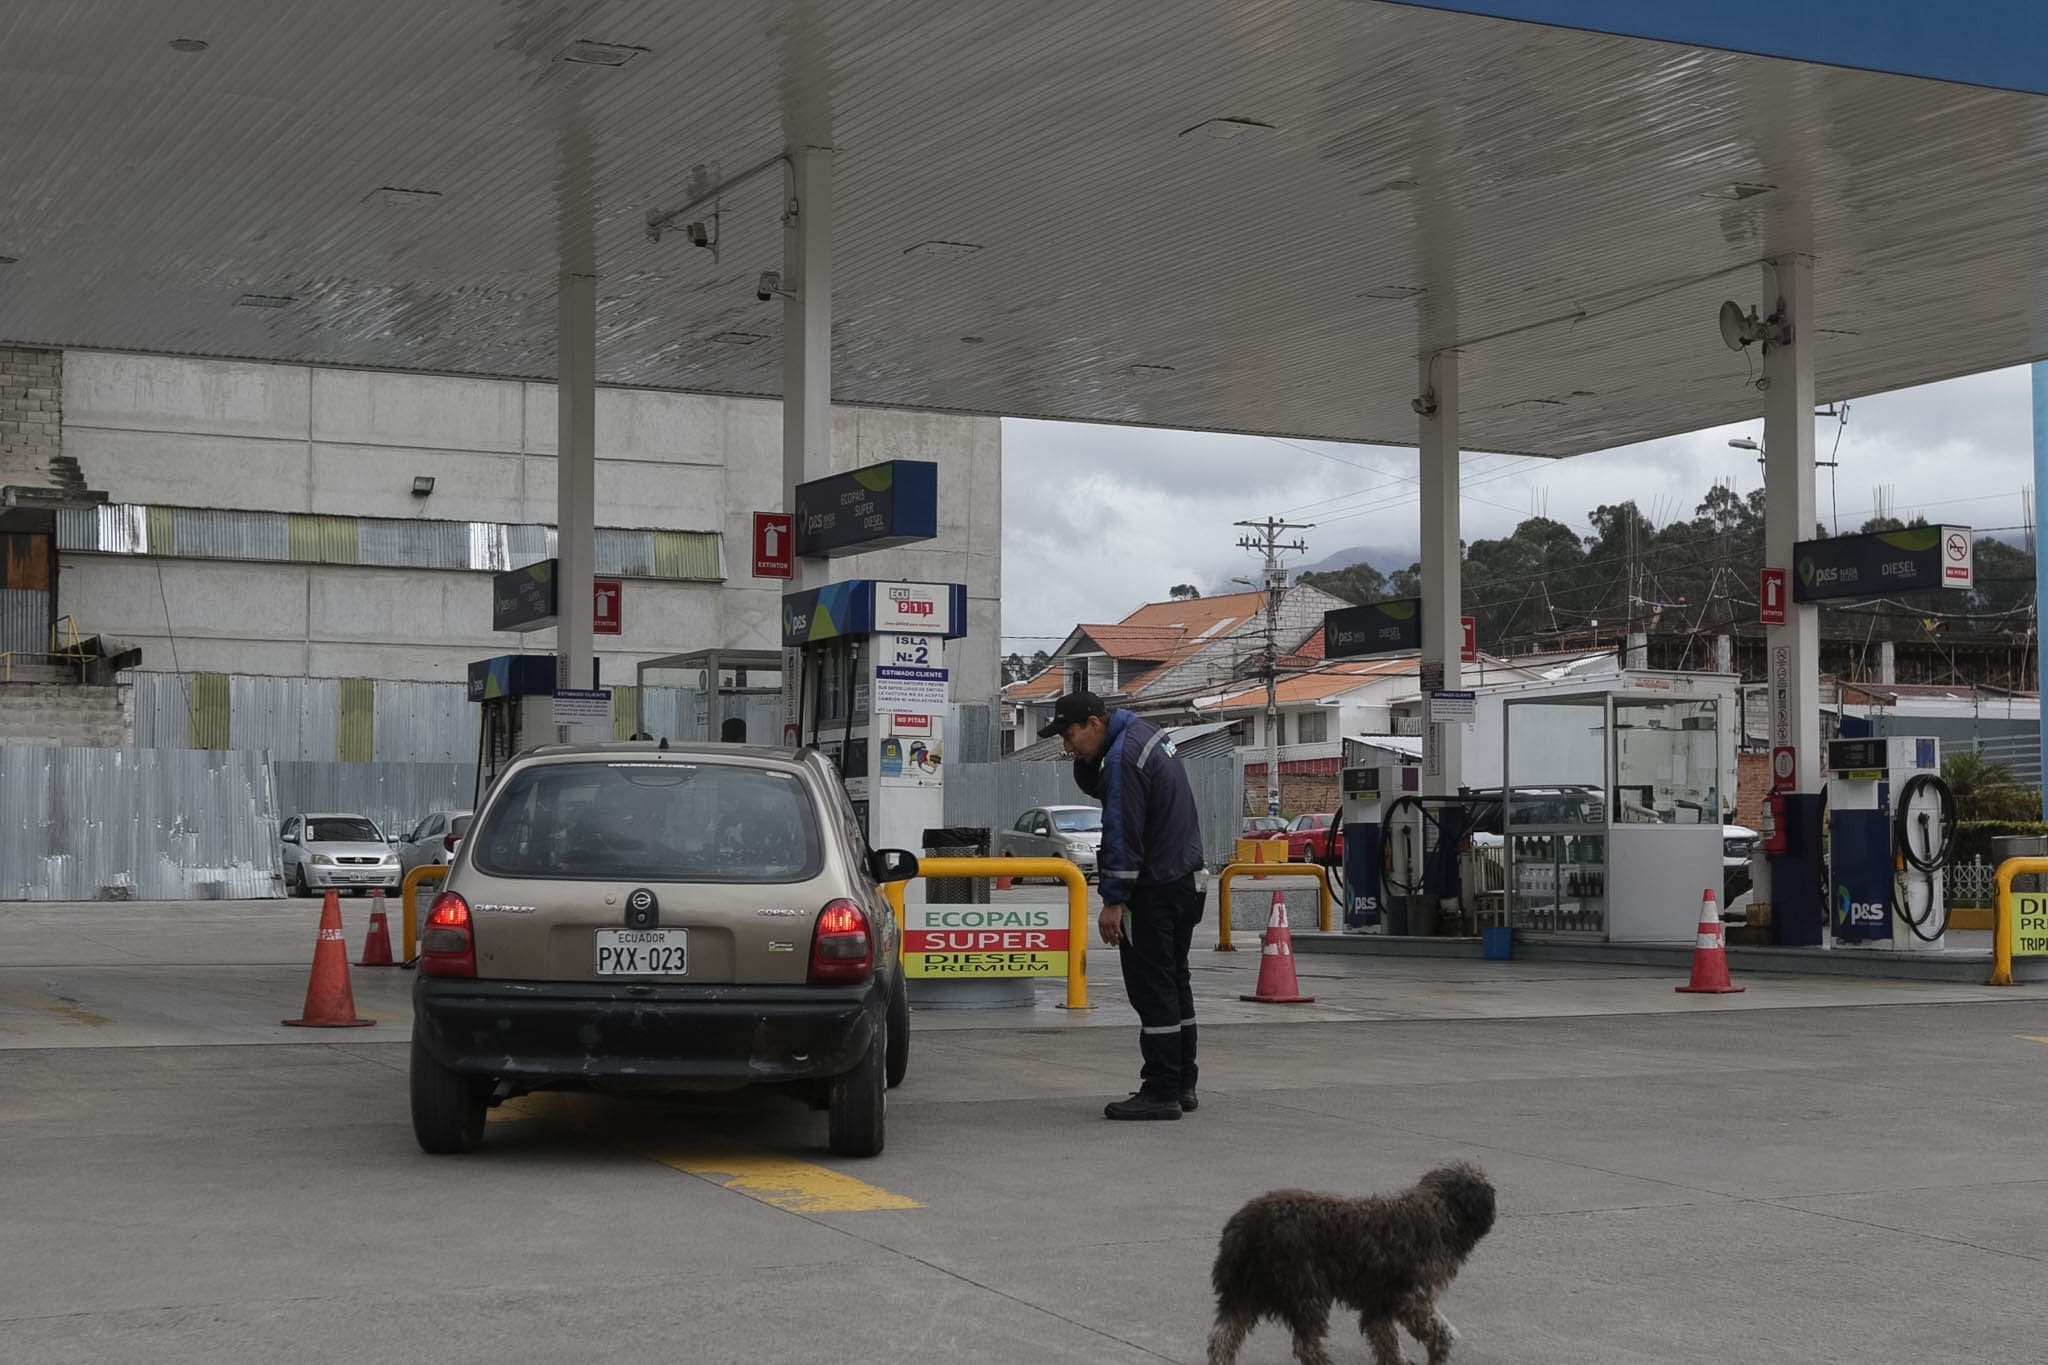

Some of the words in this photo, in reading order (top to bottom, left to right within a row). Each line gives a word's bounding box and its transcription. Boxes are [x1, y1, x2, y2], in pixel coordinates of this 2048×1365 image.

[1881, 561, 1917, 577] DIESEL
[900, 602, 931, 614] 911
[896, 636, 928, 645] ISLA
[881, 669, 915, 677] ESTIMADO
[474, 904, 536, 913] CHEVROLET
[1851, 902, 1884, 925] p&s
[925, 911, 1049, 928] ECOPAIS
[618, 932, 665, 943] ECUADOR
[925, 932, 1049, 950] SUPER
[599, 946, 685, 971] PXX-023
[925, 953, 1048, 965] DIESEL
[925, 964, 1048, 972] PREMIUM
